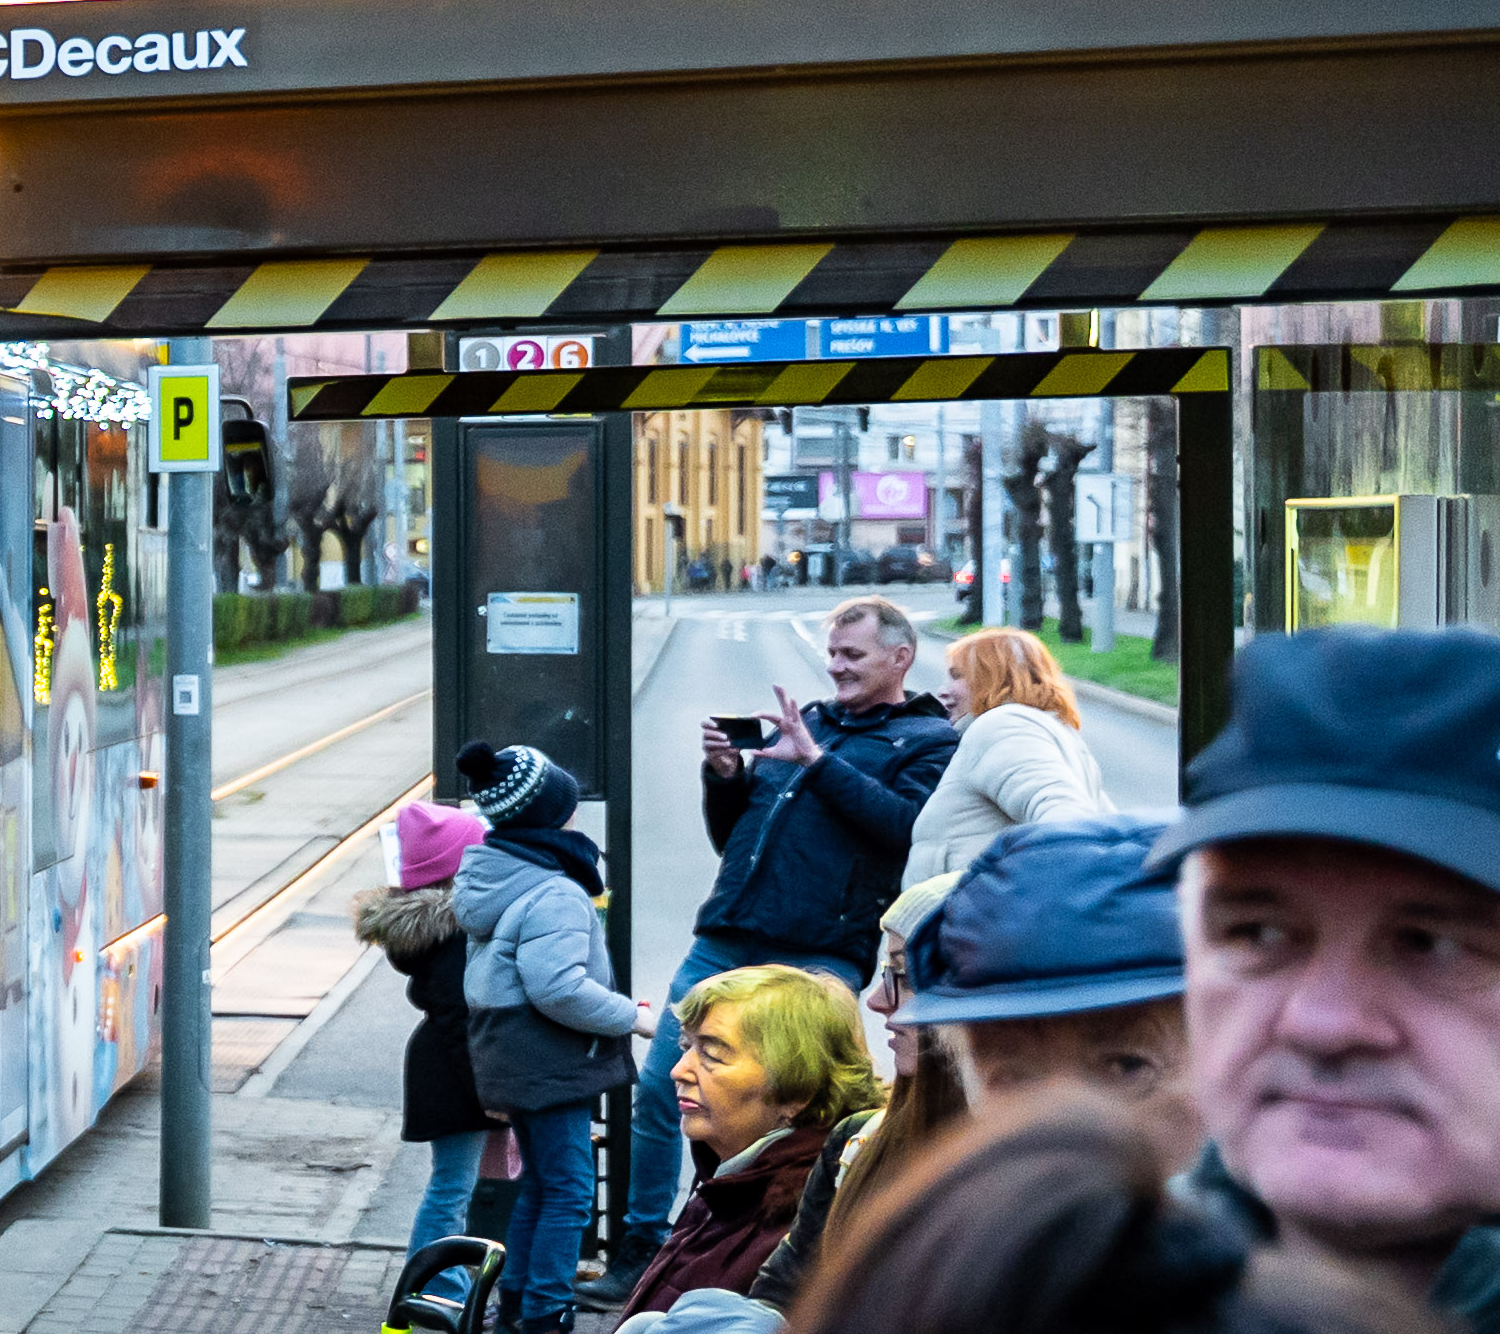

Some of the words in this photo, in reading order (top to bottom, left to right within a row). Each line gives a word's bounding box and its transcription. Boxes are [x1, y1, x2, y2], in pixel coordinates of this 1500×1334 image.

[475, 348, 487, 368] 1
[516, 344, 535, 369] 2
[560, 345, 580, 368] 6
[173, 396, 195, 440] P
